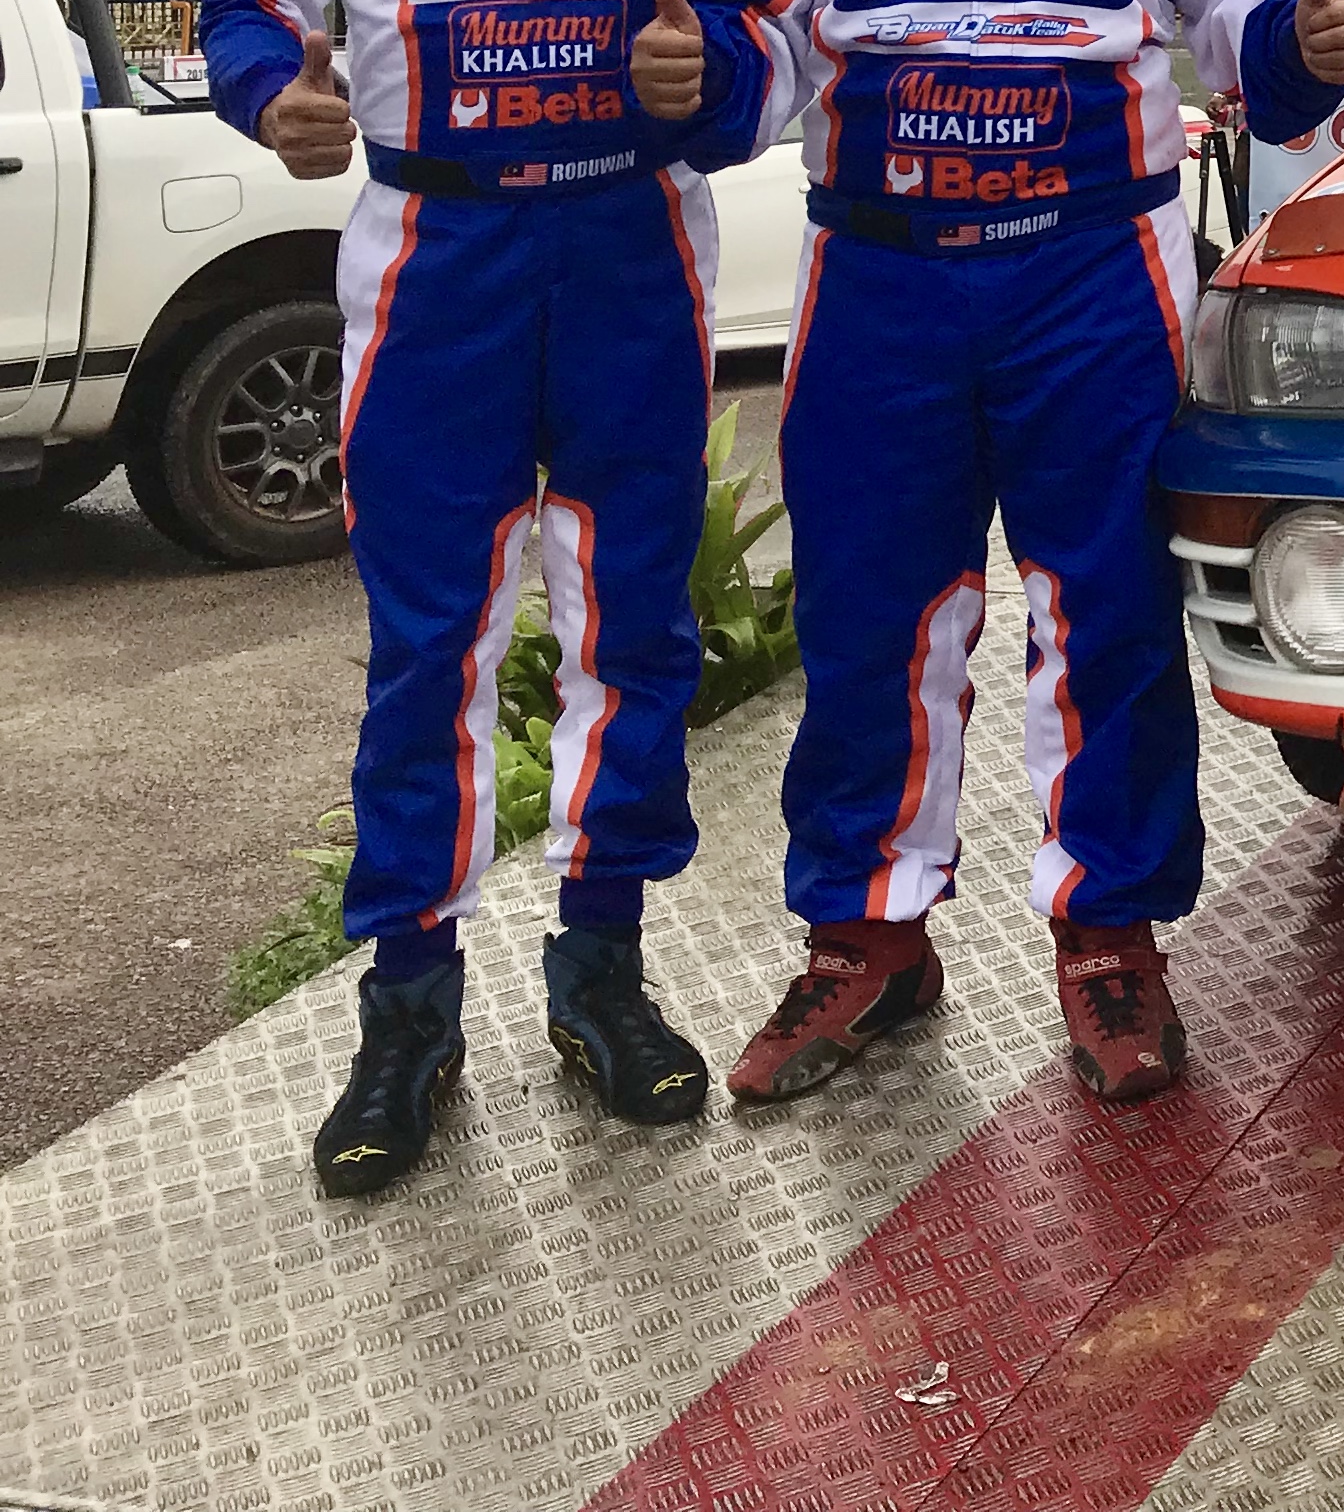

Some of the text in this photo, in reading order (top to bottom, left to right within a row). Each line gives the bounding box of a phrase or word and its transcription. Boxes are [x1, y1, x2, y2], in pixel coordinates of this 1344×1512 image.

[462, 11, 615, 50] Mummy
[867, 14, 1025, 43] Bagan Datuk
[1030, 27, 1065, 36] Team
[1033, 19, 1066, 29] Rally
[462, 44, 594, 73] KHALISH
[497, 83, 622, 127] Beta
[898, 72, 1058, 122] Mummy
[898, 113, 1034, 144] KHALISH
[552, 150, 635, 182] RODUWAN
[931, 155, 1069, 202] Beta
[985, 210, 1058, 241] SUHAIMI
[1065, 955, 1120, 977] sparco
